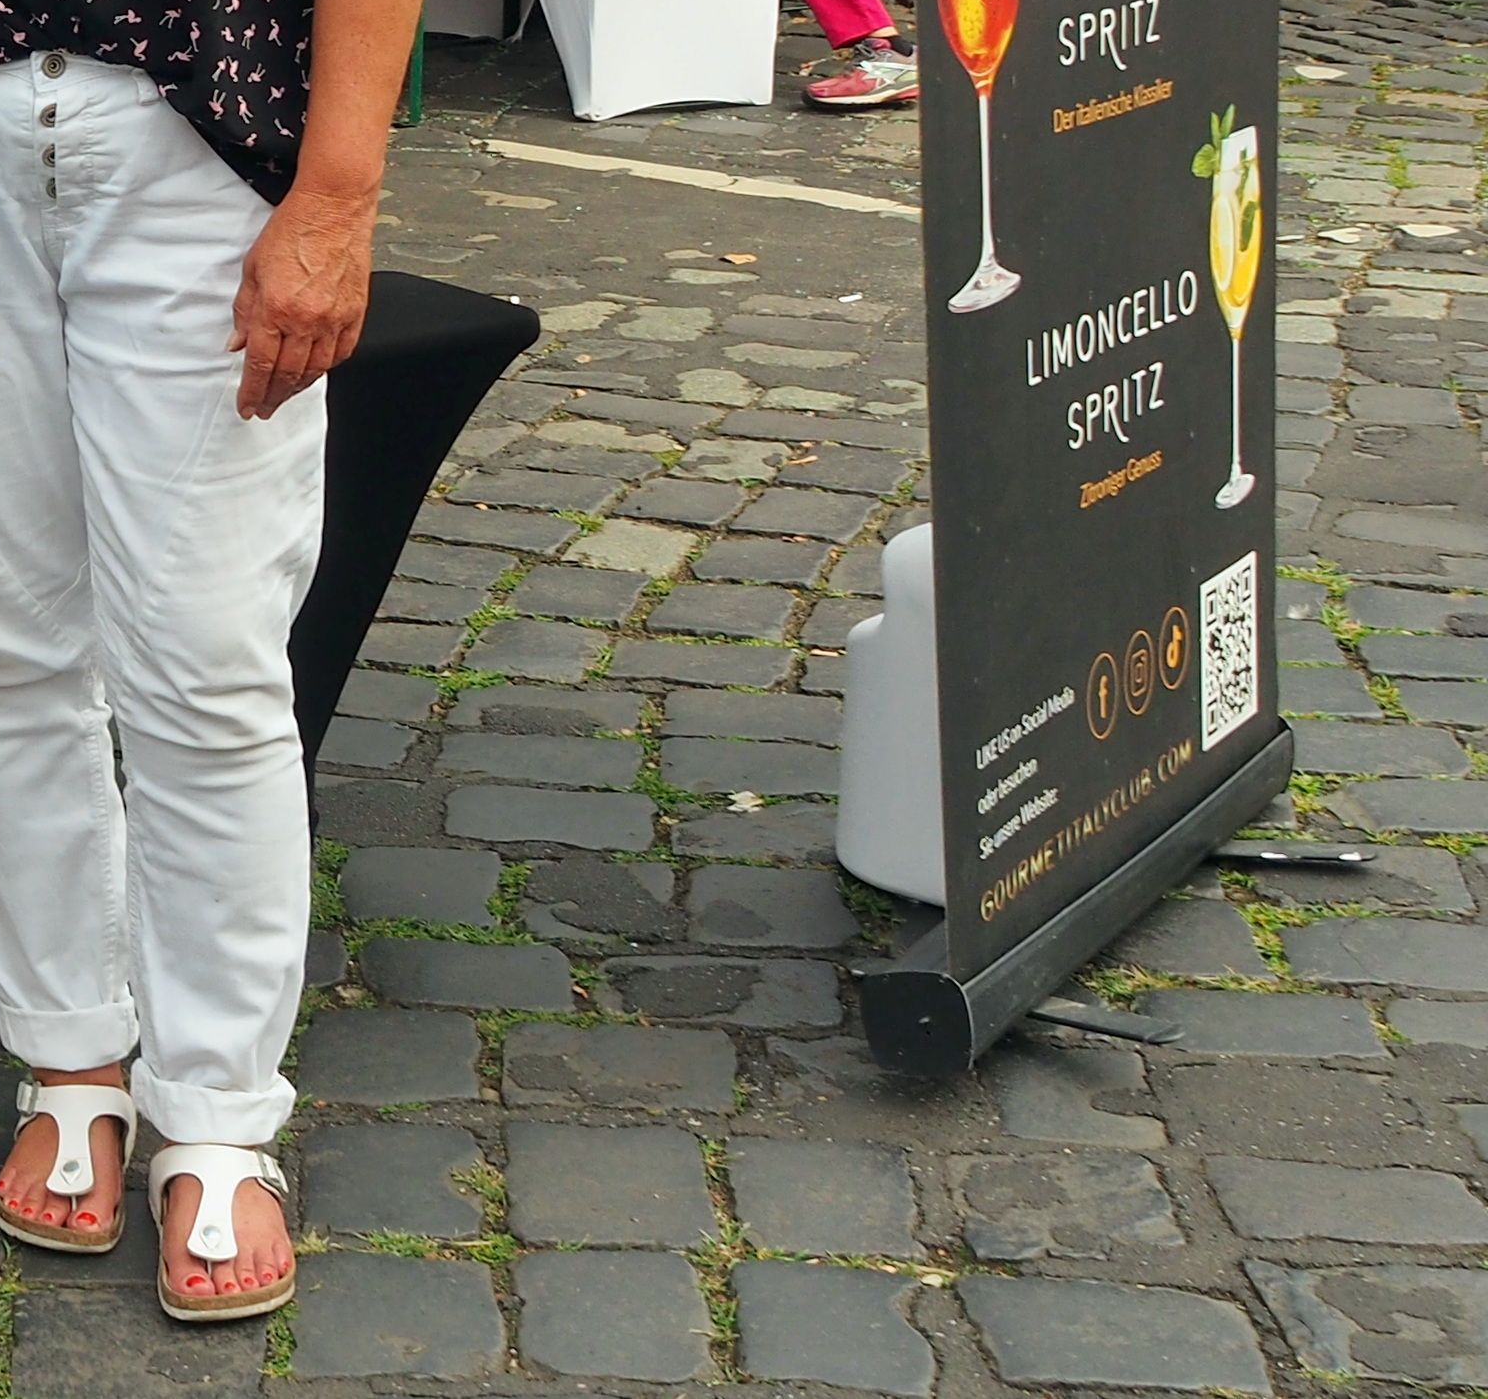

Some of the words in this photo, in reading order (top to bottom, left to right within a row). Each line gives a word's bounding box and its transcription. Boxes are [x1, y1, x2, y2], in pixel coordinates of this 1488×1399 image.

[1053, 109, 1075, 133] Der
[1026, 270, 1198, 387] LIMONCELLO
[1067, 361, 1164, 450] SPRITZ
[976, 737, 999, 770] LIKE
